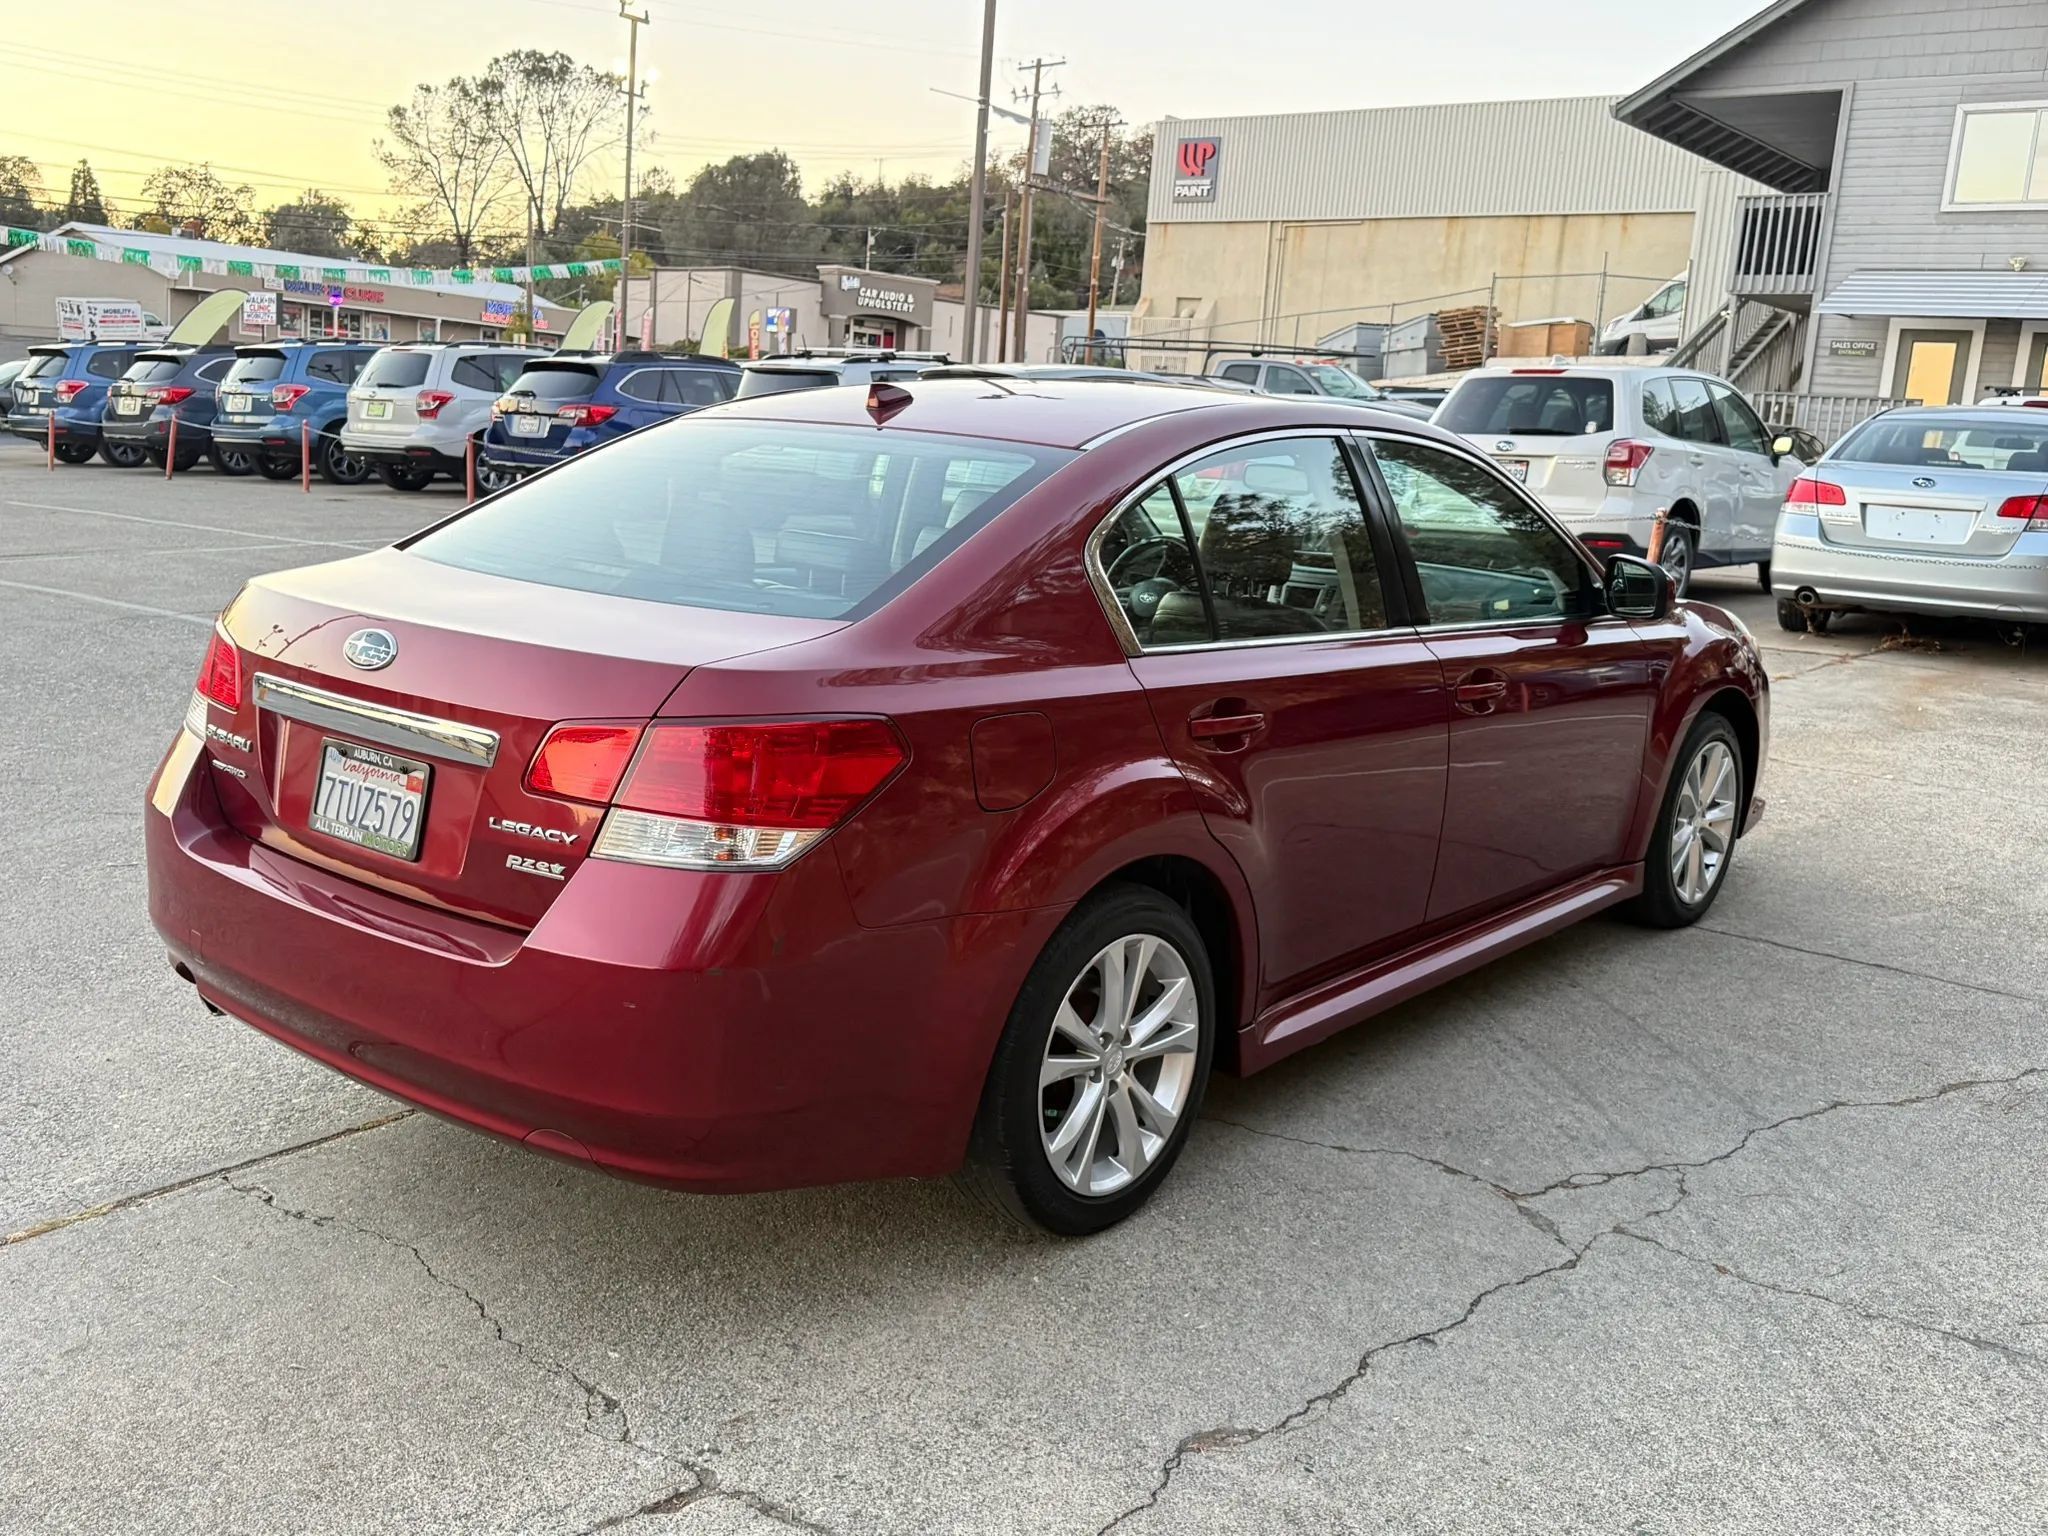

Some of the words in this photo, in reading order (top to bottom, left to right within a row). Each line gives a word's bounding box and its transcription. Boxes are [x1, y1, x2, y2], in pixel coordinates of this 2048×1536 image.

[1174, 185, 1213, 197] PAINT
[857, 296, 914, 313] UPHOLSTERY
[859, 287, 878, 298] CAR
[879, 290, 905, 302] AUDIO
[249, 304, 272, 312] CLINIC
[1831, 341, 1850, 349] SALES
[1852, 342, 1876, 350] OFFICE
[206, 723, 252, 753] SUBARU
[353, 748, 382, 765] AUBURN,
[382, 756, 394, 768] CA
[342, 758, 406, 787] California
[323, 775, 415, 841] 7TUZ579
[315, 819, 330, 832] ALL
[331, 823, 363, 843] TERRAIN
[364, 833, 409, 857] MOTORS
[488, 816, 579, 846] LEGACY
